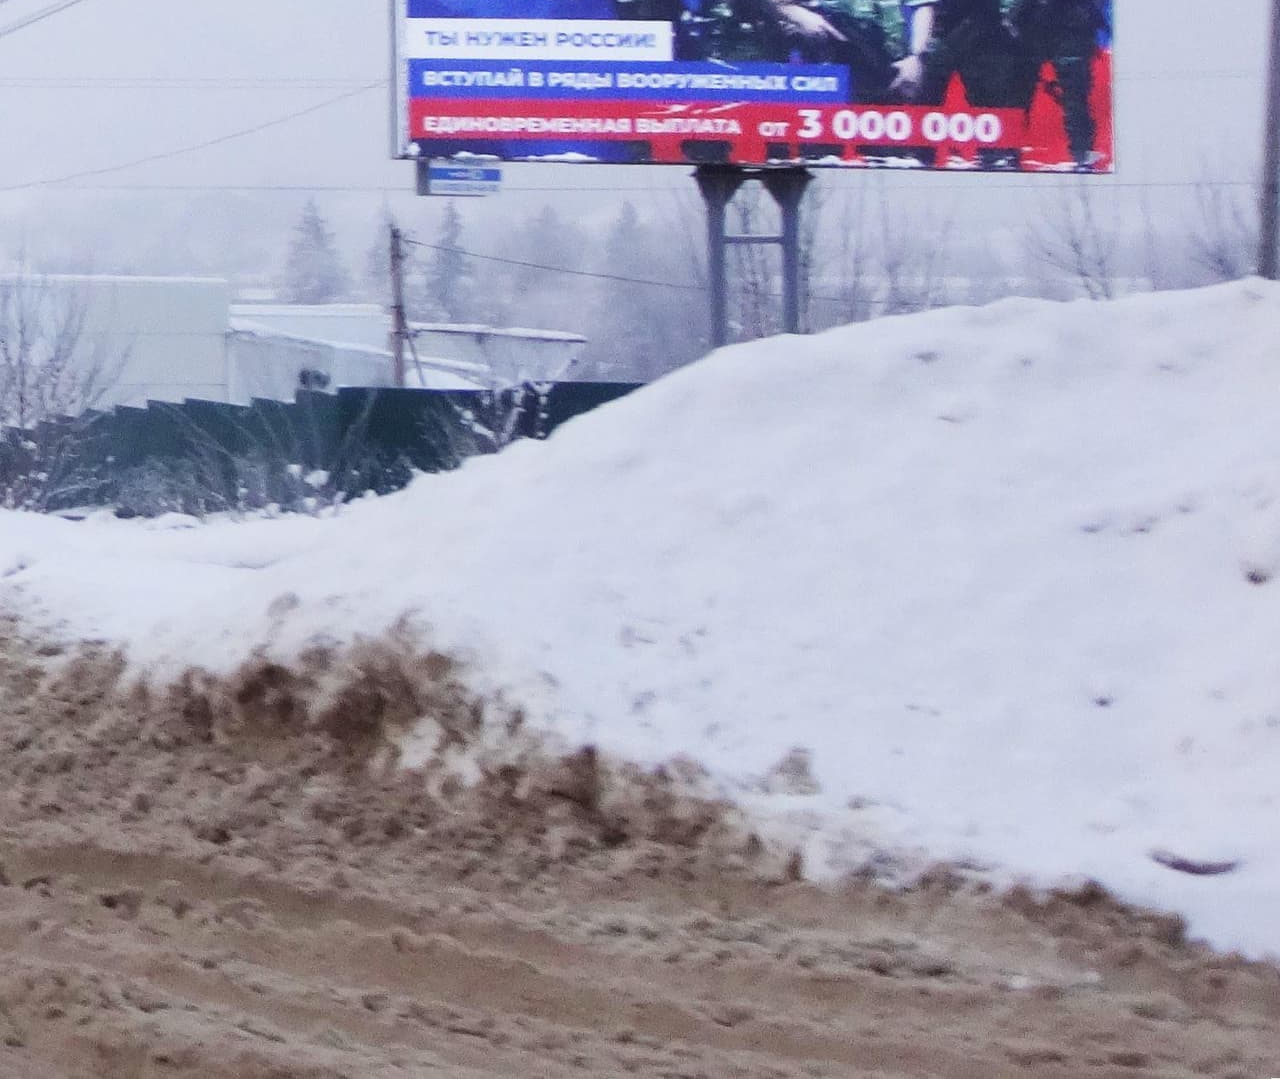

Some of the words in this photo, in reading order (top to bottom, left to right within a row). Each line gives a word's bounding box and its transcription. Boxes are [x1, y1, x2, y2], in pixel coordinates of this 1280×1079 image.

[425, 30, 458, 47] ТЫ
[467, 31, 548, 47] НУЖЕН
[556, 31, 656, 48] РОССИИ!
[423, 68, 524, 87] ВСТУПАЙ
[528, 71, 544, 87] В
[547, 72, 613, 90] РЯДЫ
[617, 73, 788, 90] ВООРУЖЕННЫХ
[792, 76, 838, 91] СИЛ
[424, 116, 632, 134] ЕДИНОВРЕМЕННАЯ
[635, 118, 742, 134] ВЫПЛАТА
[797, 108, 824, 139] 3
[832, 110, 912, 141] 000
[922, 112, 1002, 143] 000
